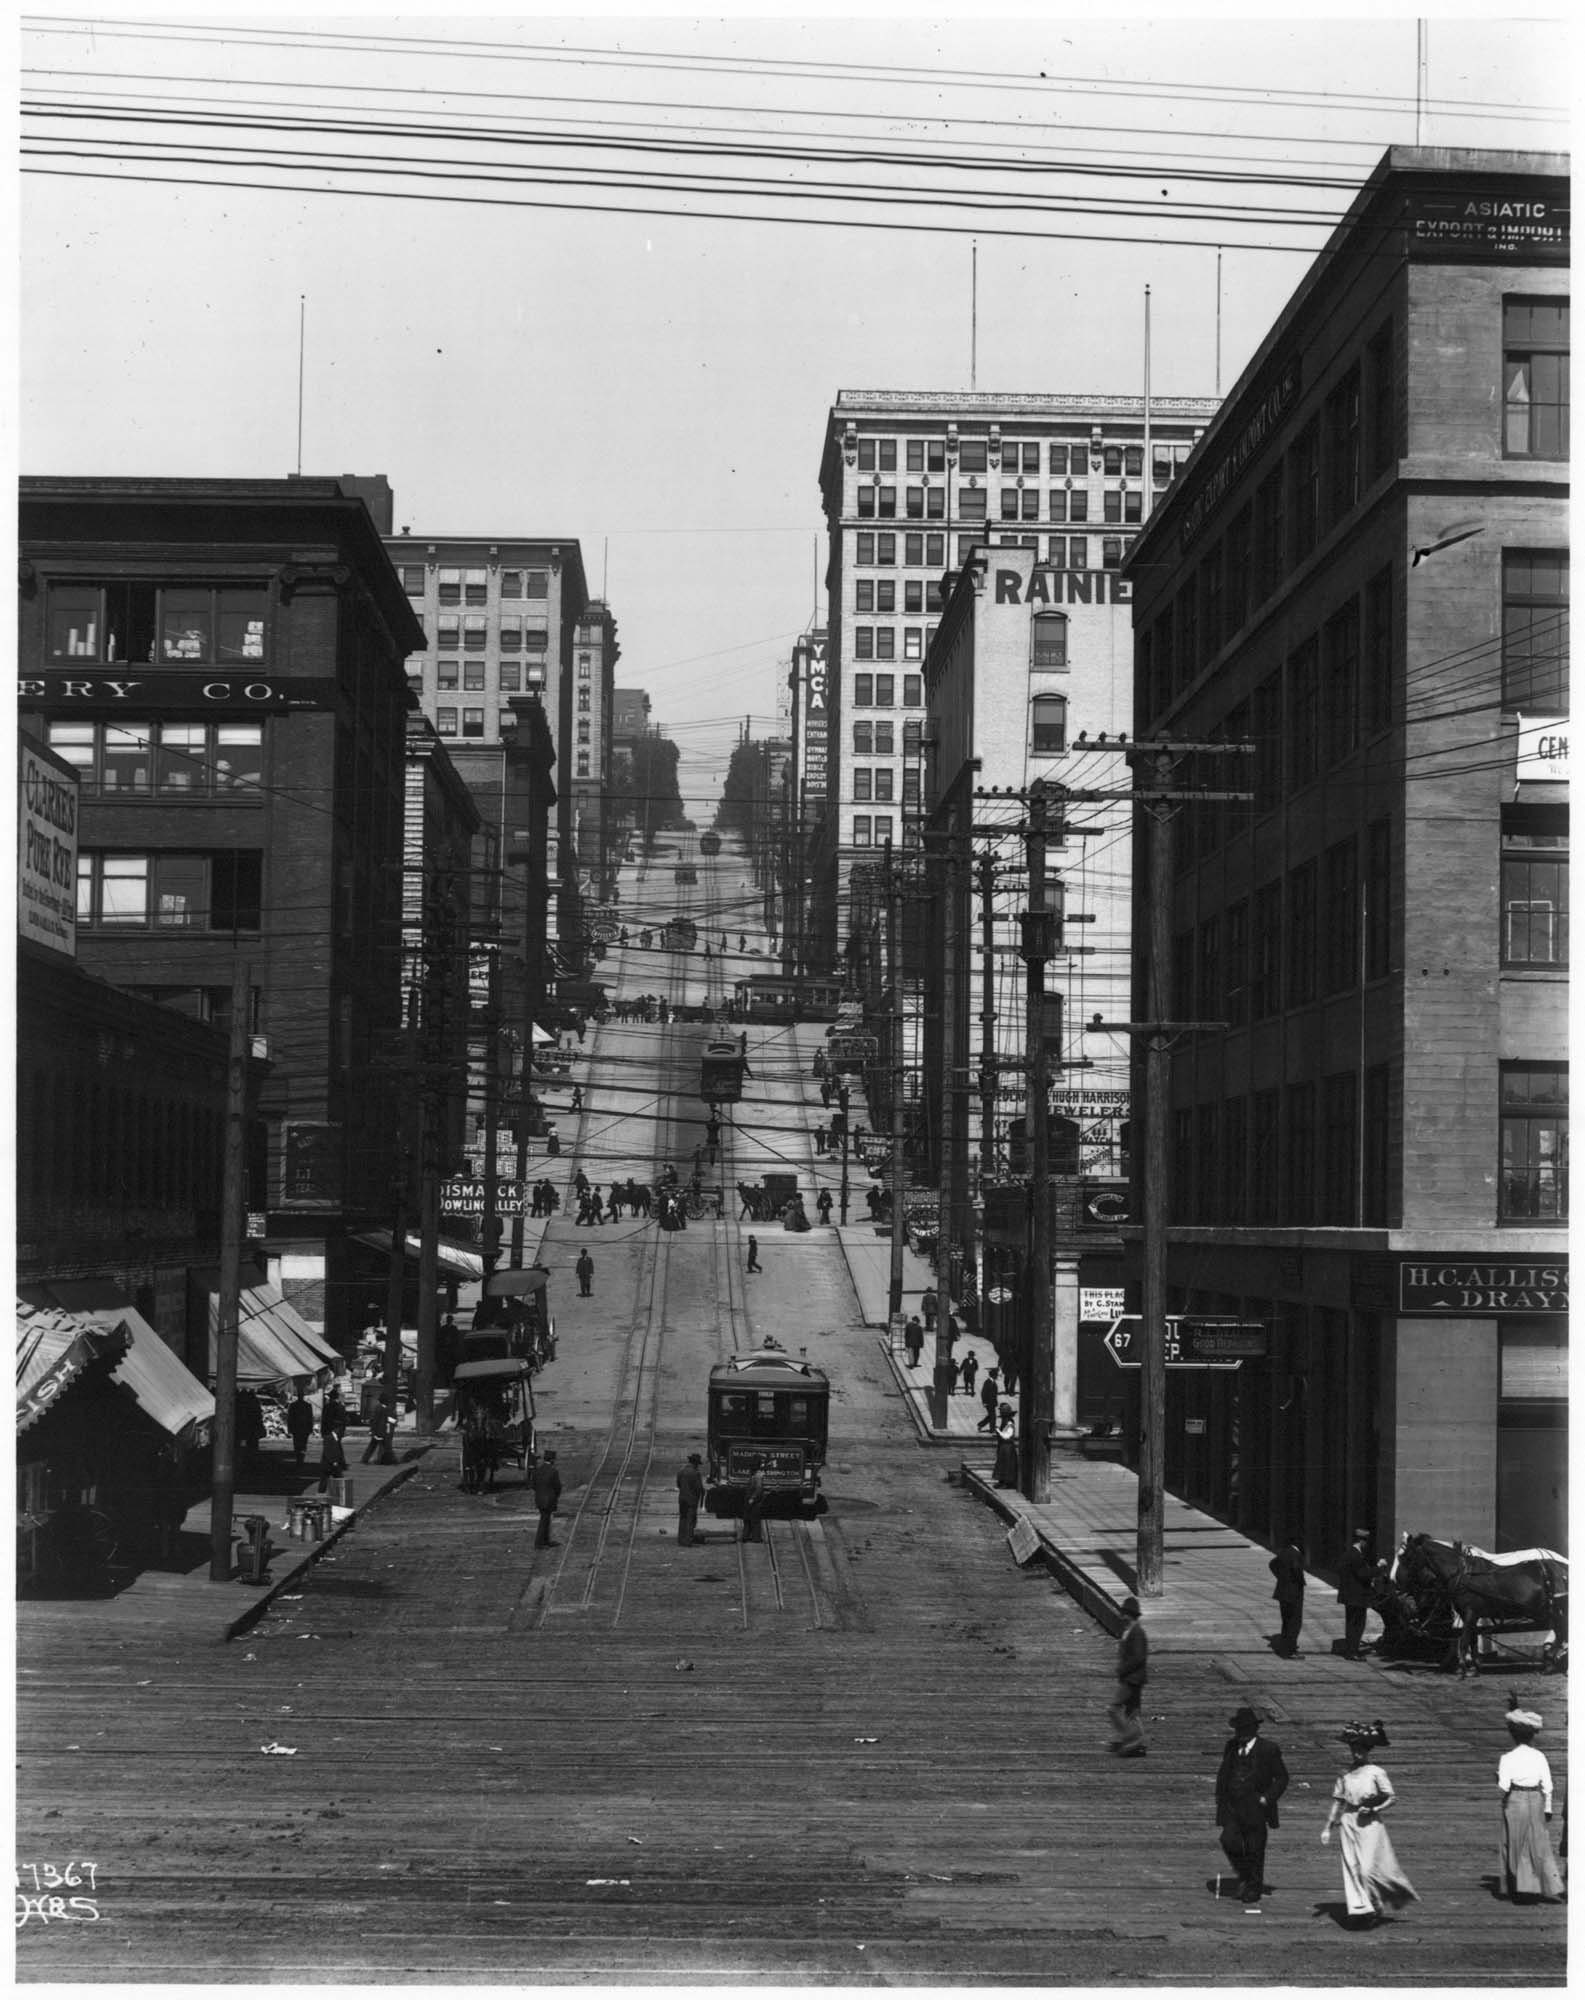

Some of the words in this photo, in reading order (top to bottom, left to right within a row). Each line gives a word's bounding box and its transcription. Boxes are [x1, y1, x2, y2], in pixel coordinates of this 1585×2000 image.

[1464, 202, 1546, 218] ASIATIC
[1416, 219, 1485, 238] EXPORT
[1501, 224, 1562, 242] IMPORT
[810, 645, 826, 708] YMCA
[17, 680, 143, 697] ERY
[203, 683, 285, 700] CO.
[26, 818, 51, 880] PURE
[53, 836, 71, 890] RYE
[1052, 1092, 1079, 1103] HUGH
[440, 1184, 517, 1197] ISMACK
[1114, 1333, 1131, 1348] 67
